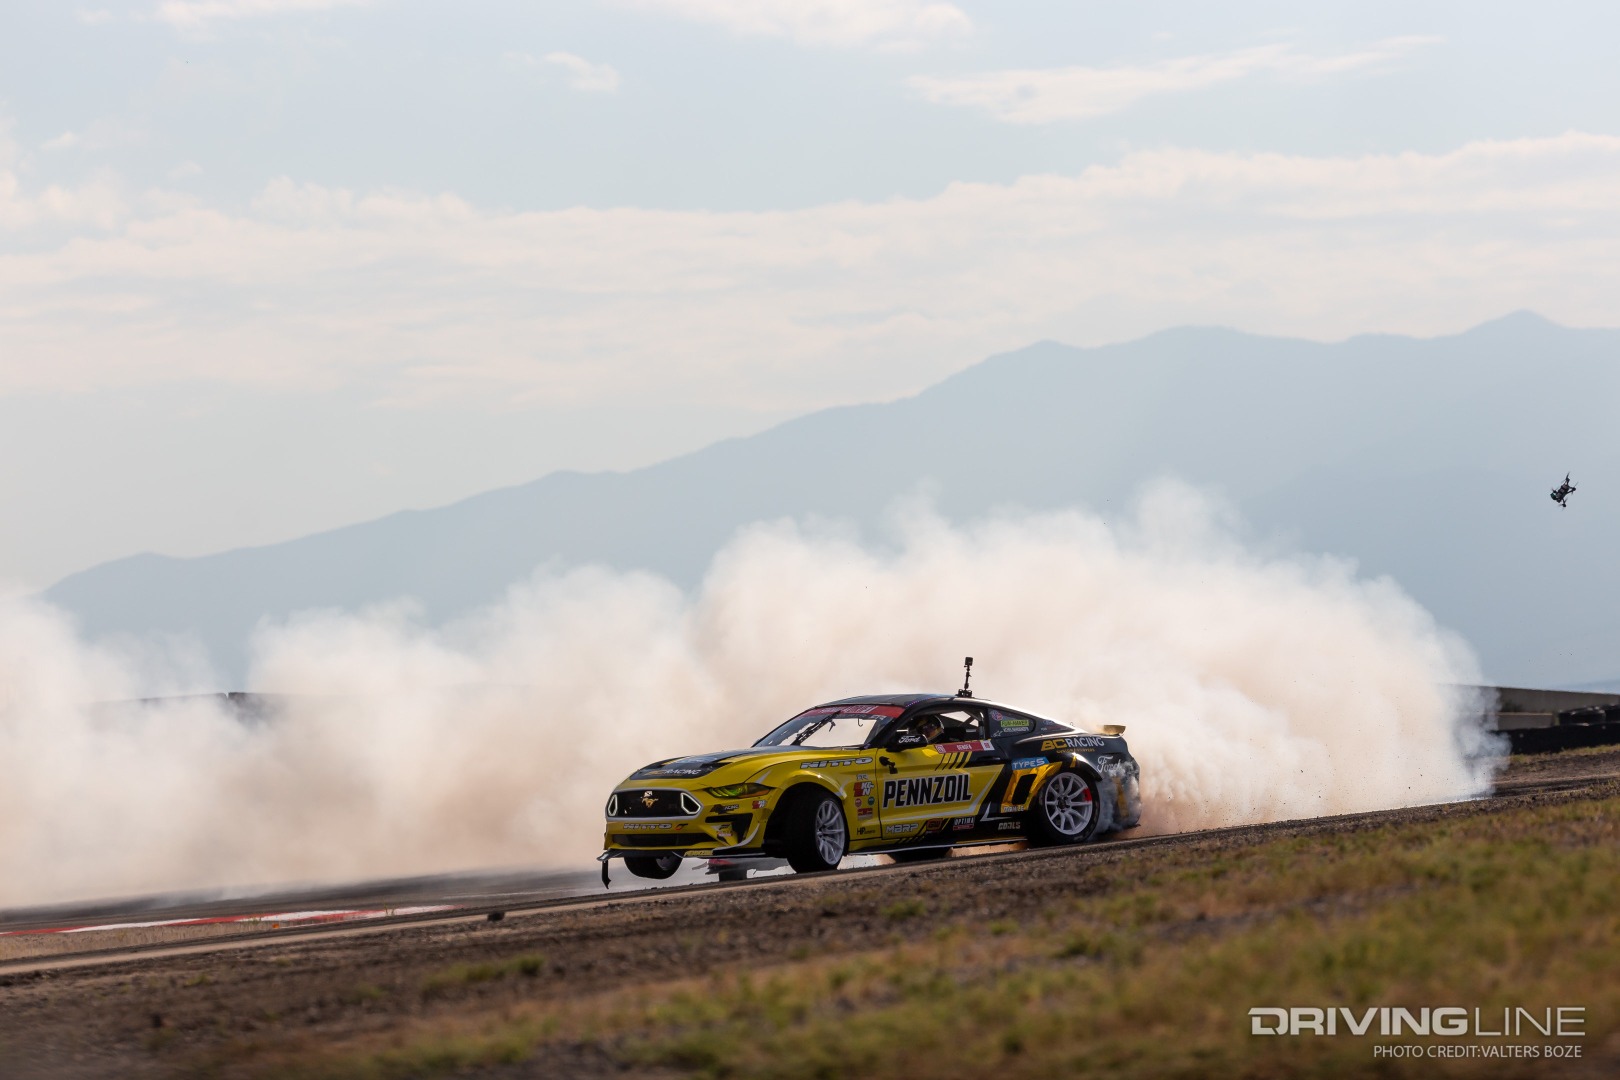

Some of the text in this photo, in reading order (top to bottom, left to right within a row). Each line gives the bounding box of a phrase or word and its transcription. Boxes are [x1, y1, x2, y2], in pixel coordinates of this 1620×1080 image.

[898, 735, 920, 743] Ford
[800, 757, 873, 769] NITTO
[882, 773, 972, 809] PENNZOIL
